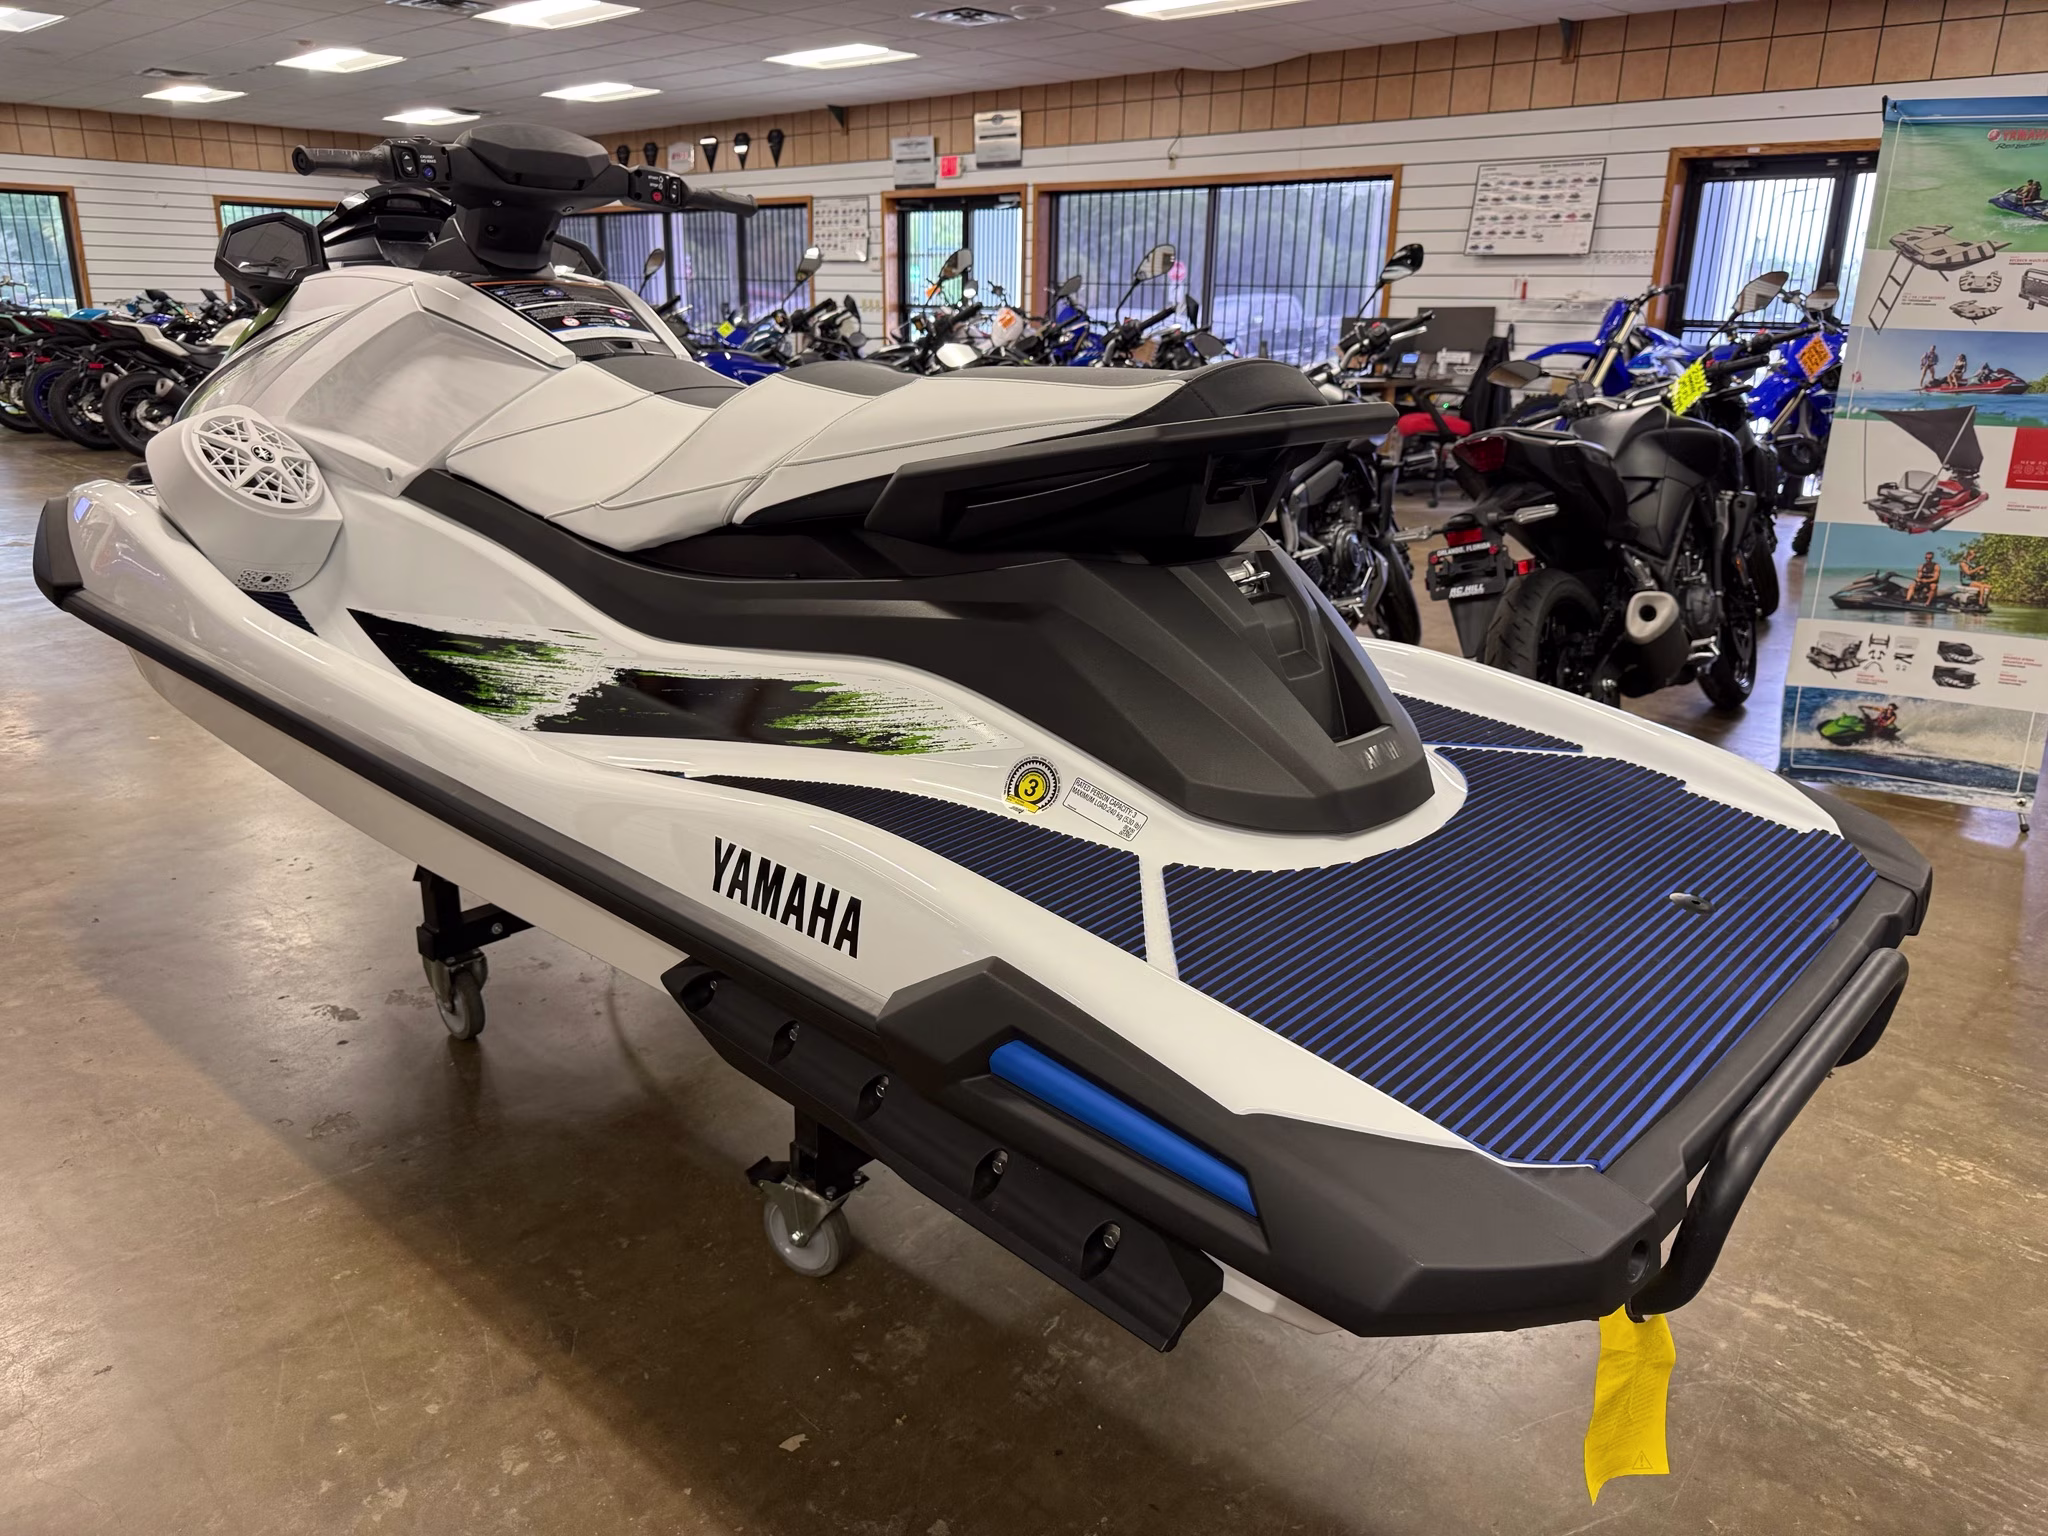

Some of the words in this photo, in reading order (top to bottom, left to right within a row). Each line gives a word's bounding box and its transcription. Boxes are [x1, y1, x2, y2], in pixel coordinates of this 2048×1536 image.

[2012, 464, 2048, 476] 202
[1466, 542, 1490, 551] FLORIDA
[1024, 778, 1039, 797] 3
[1075, 779, 1091, 793] RATED
[1090, 787, 1110, 804] PERSON
[1109, 796, 1133, 815] CAPACITY:
[1072, 787, 1095, 803] MAXIMUM
[1116, 811, 1123, 822] kg
[1121, 815, 1135, 826] (530
[712, 836, 862, 959] YAMAHA
